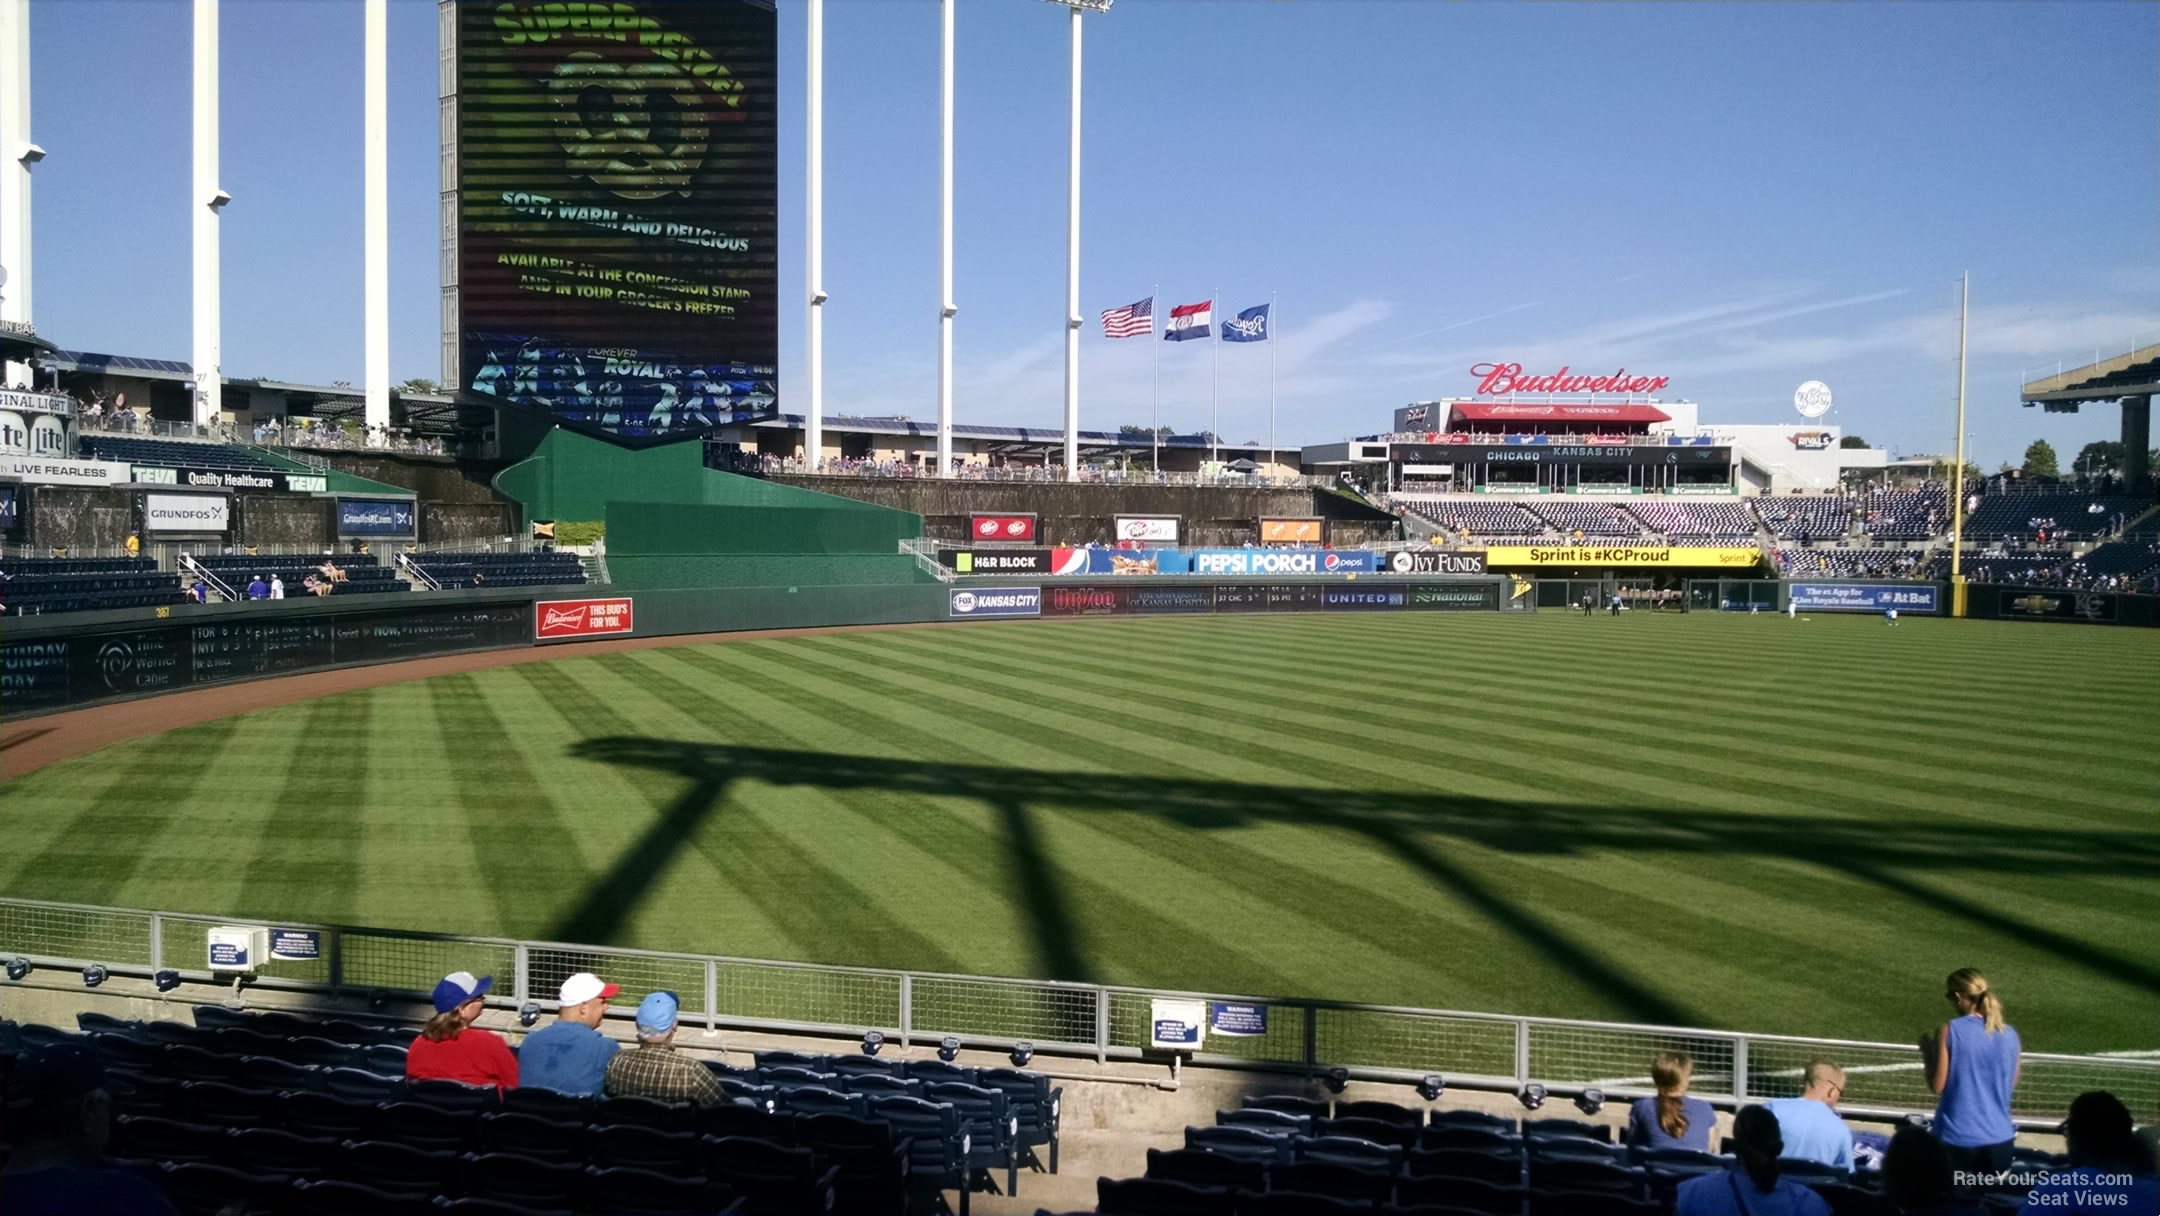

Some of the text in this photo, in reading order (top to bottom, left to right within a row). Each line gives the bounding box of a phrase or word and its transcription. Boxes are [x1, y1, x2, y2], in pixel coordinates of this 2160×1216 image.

[501, 191, 749, 252] SOFT, WARM AND DELICIOUS
[498, 253, 751, 302] AVAILABLE AT THE CONCESSION STAND
[518, 275, 553, 293] AND
[555, 281, 572, 296] IN
[575, 284, 613, 301] YOUR
[685, 301, 736, 320] FREEZER
[16, 322, 37, 335] BAR
[588, 347, 638, 359] FOREVER
[603, 358, 665, 379] ROYAL
[1470, 362, 1670, 395] Budweiser
[0, 394, 35, 409] INAL
[38, 397, 66, 411] LIGHT
[1797, 387, 1830, 409] 360
[36, 427, 63, 454] Lite
[1798, 437, 1830, 446] RIVALS
[1487, 451, 1540, 461] CHICAGO
[1553, 447, 1633, 457] KANSAS CITY
[14, 464, 41, 474] LIVE
[45, 466, 107, 478] FEARLESS
[132, 467, 178, 485] TEVA
[188, 471, 274, 488] Quality Healthcare
[285, 475, 327, 492] TEVA
[1524, 486, 1540, 494] Bank
[1616, 486, 1632, 494] Bank
[1713, 486, 1732, 494] Bank
[151, 508, 210, 520] GRUNDFOS
[974, 556, 1037, 568] H&R BLOCK
[1198, 553, 1316, 572] PEPSI PORCH
[1339, 557, 1364, 569] pepsi
[1438, 553, 1482, 571] FUNDS
[1530, 549, 1670, 565] Sprint is #KCProud
[1719, 553, 1746, 565] Sprint
[1218, 594, 1227, 602] 37
[1228, 594, 1242, 602] CHC
[1271, 594, 1280, 602] 55
[1281, 594, 1291, 602] PIT
[1329, 594, 1386, 603] UNITED
[1832, 588, 1849, 597] App
[1850, 588, 1863, 596] for
[1893, 592, 1931, 604] At Bat
[958, 597, 973, 605] FOX
[978, 594, 1038, 608] KANSAS CITY
[1130, 598, 1210, 607] OF KANSAS HOSPITAL
[1813, 597, 1840, 606] Royals
[1841, 597, 1874, 605] Baseball
[589, 603, 628, 616] THIS BUD'S
[546, 612, 583, 624] Budweiser
[589, 616, 621, 629] FOR YOU.
[197, 626, 216, 639] TOR
[337, 628, 360, 640] Sprint
[136, 634, 165, 652] Time
[198, 642, 215, 654] NYY
[136, 652, 178, 670] Warner
[136, 672, 169, 687] Cable
[1226, 1006, 1255, 1014] WARNING
